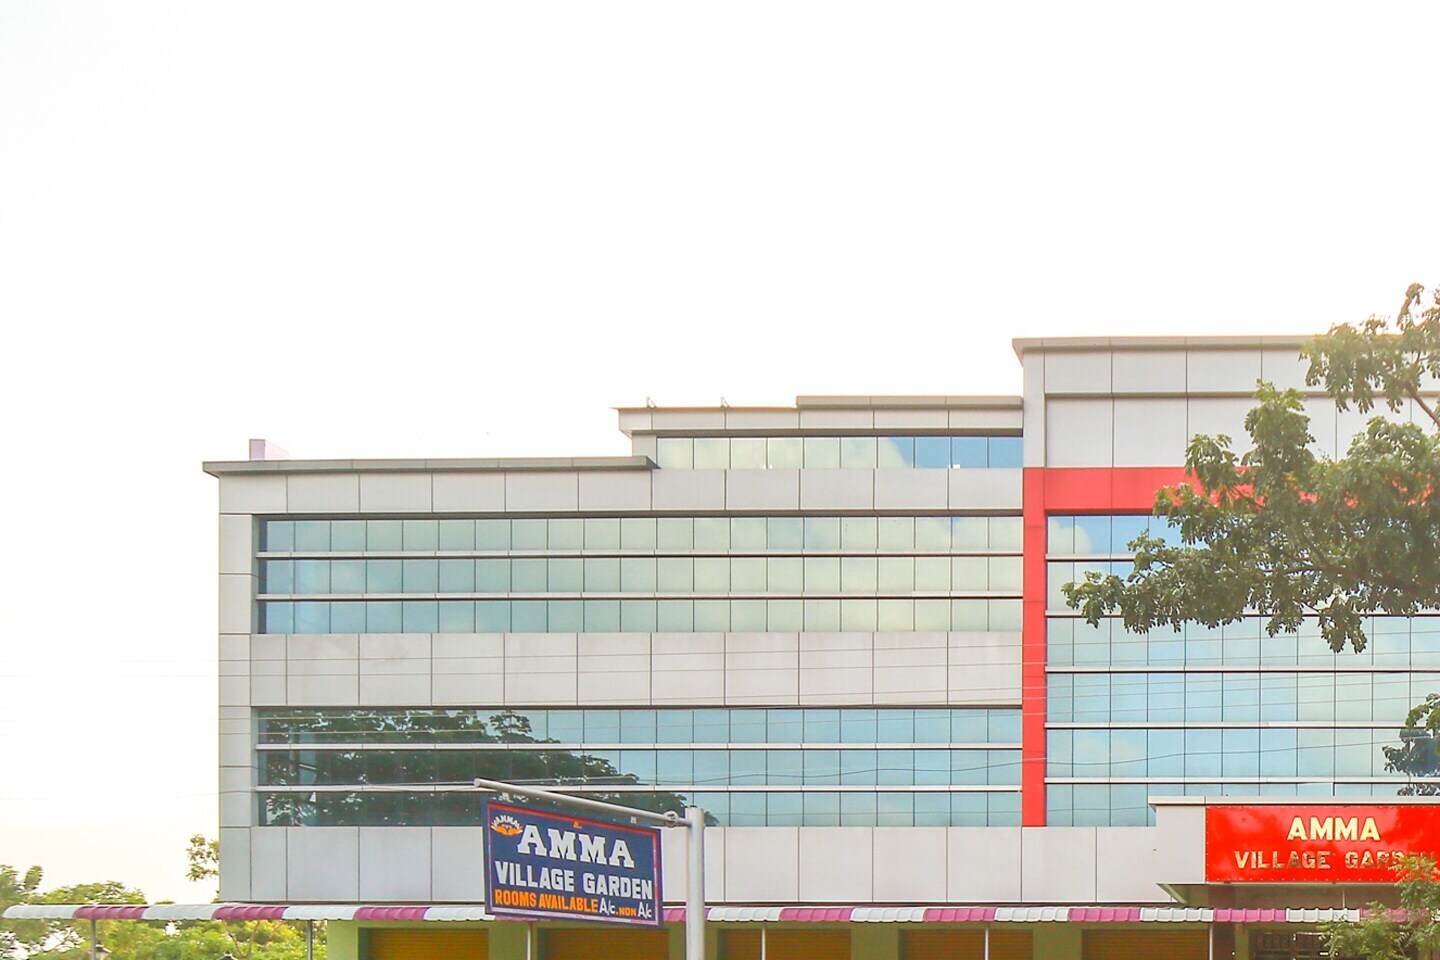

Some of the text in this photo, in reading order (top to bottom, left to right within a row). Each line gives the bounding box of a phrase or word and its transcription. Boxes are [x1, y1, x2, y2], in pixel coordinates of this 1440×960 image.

[1286, 816, 1381, 841] AMMA
[517, 824, 635, 868] AMMA
[1234, 850, 1331, 870] VILLAGE
[495, 860, 653, 900] VILLAGE GARDEN
[495, 889, 537, 908] ROOMS
[538, 895, 598, 913] AVAILABLE
